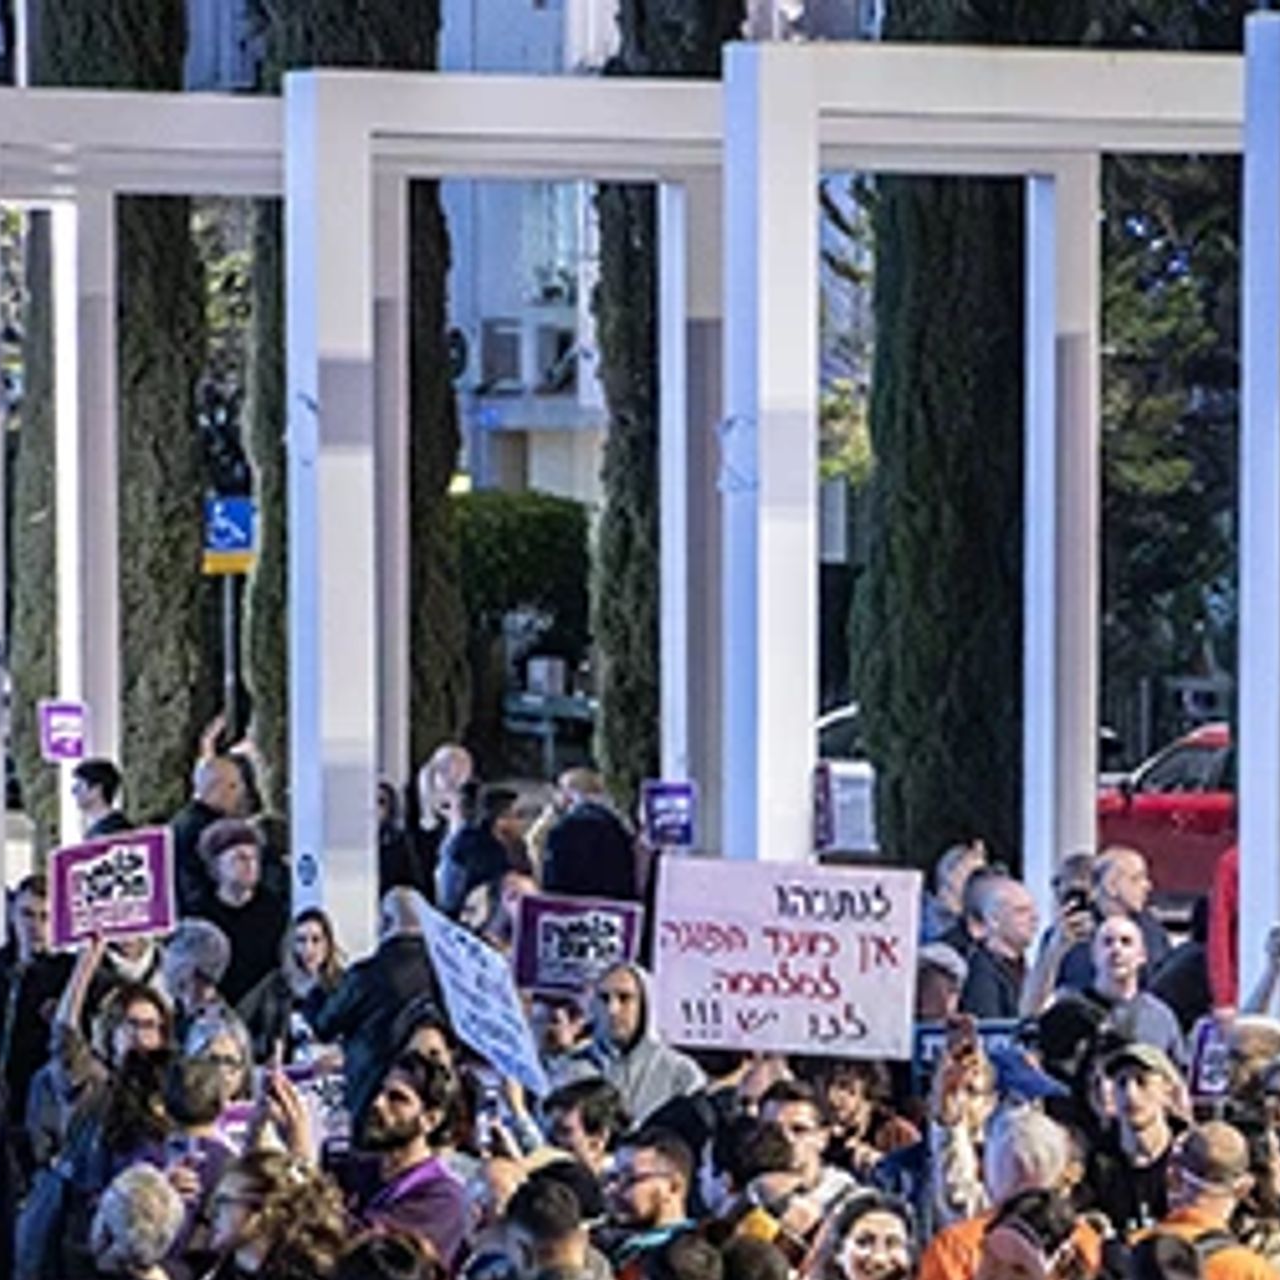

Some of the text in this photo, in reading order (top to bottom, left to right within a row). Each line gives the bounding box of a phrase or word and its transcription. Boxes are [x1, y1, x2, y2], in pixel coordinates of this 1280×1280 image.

[774, 883, 892, 922] לנתניהו
[712, 960, 842, 1001] למלחמה
[736, 1009, 779, 1033] יש
[808, 1003, 868, 1041] לנו
